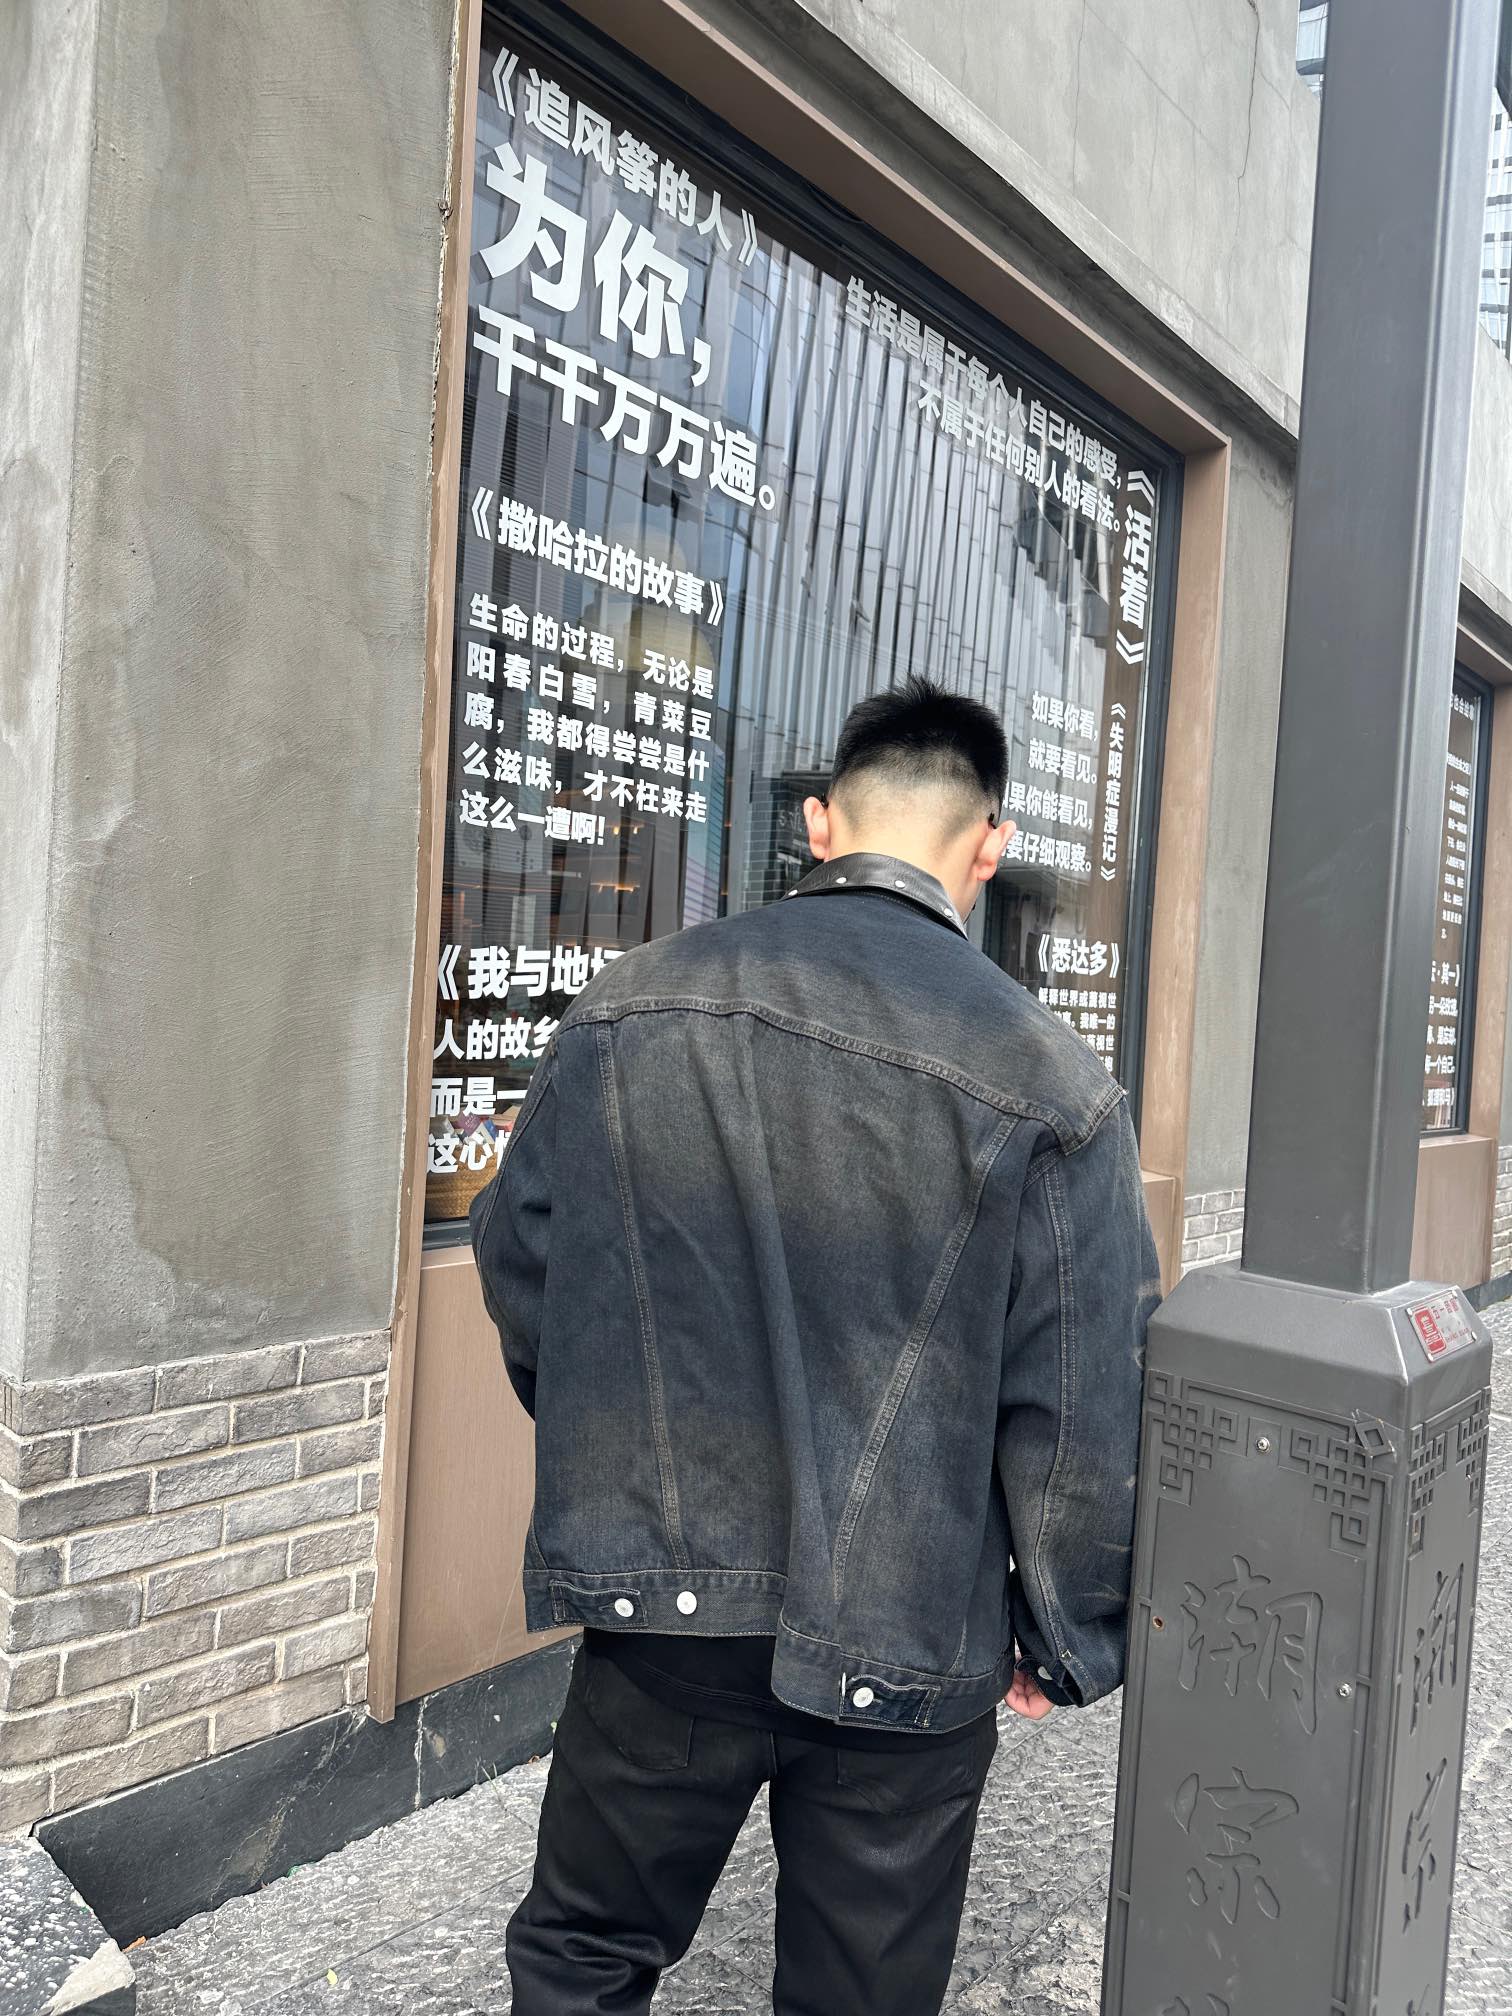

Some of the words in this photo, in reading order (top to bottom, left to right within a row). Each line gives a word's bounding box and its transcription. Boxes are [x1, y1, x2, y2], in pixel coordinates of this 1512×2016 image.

[492, 46, 758, 267] 《追风筝的人》
[917, 379, 1120, 534] 不属于任何别人的看法。
[471, 486, 724, 626] 《撒哈拉的故事》
[1116, 469, 1155, 665] 《活着》
[1028, 737, 1097, 785] 就要看见。
[1100, 702, 1126, 882] 《失明症漫记》
[1001, 830, 1092, 873] 要仔细观察。
[1038, 933, 1120, 979] 《悉达多》
[429, 1075, 535, 1118] 而是一
